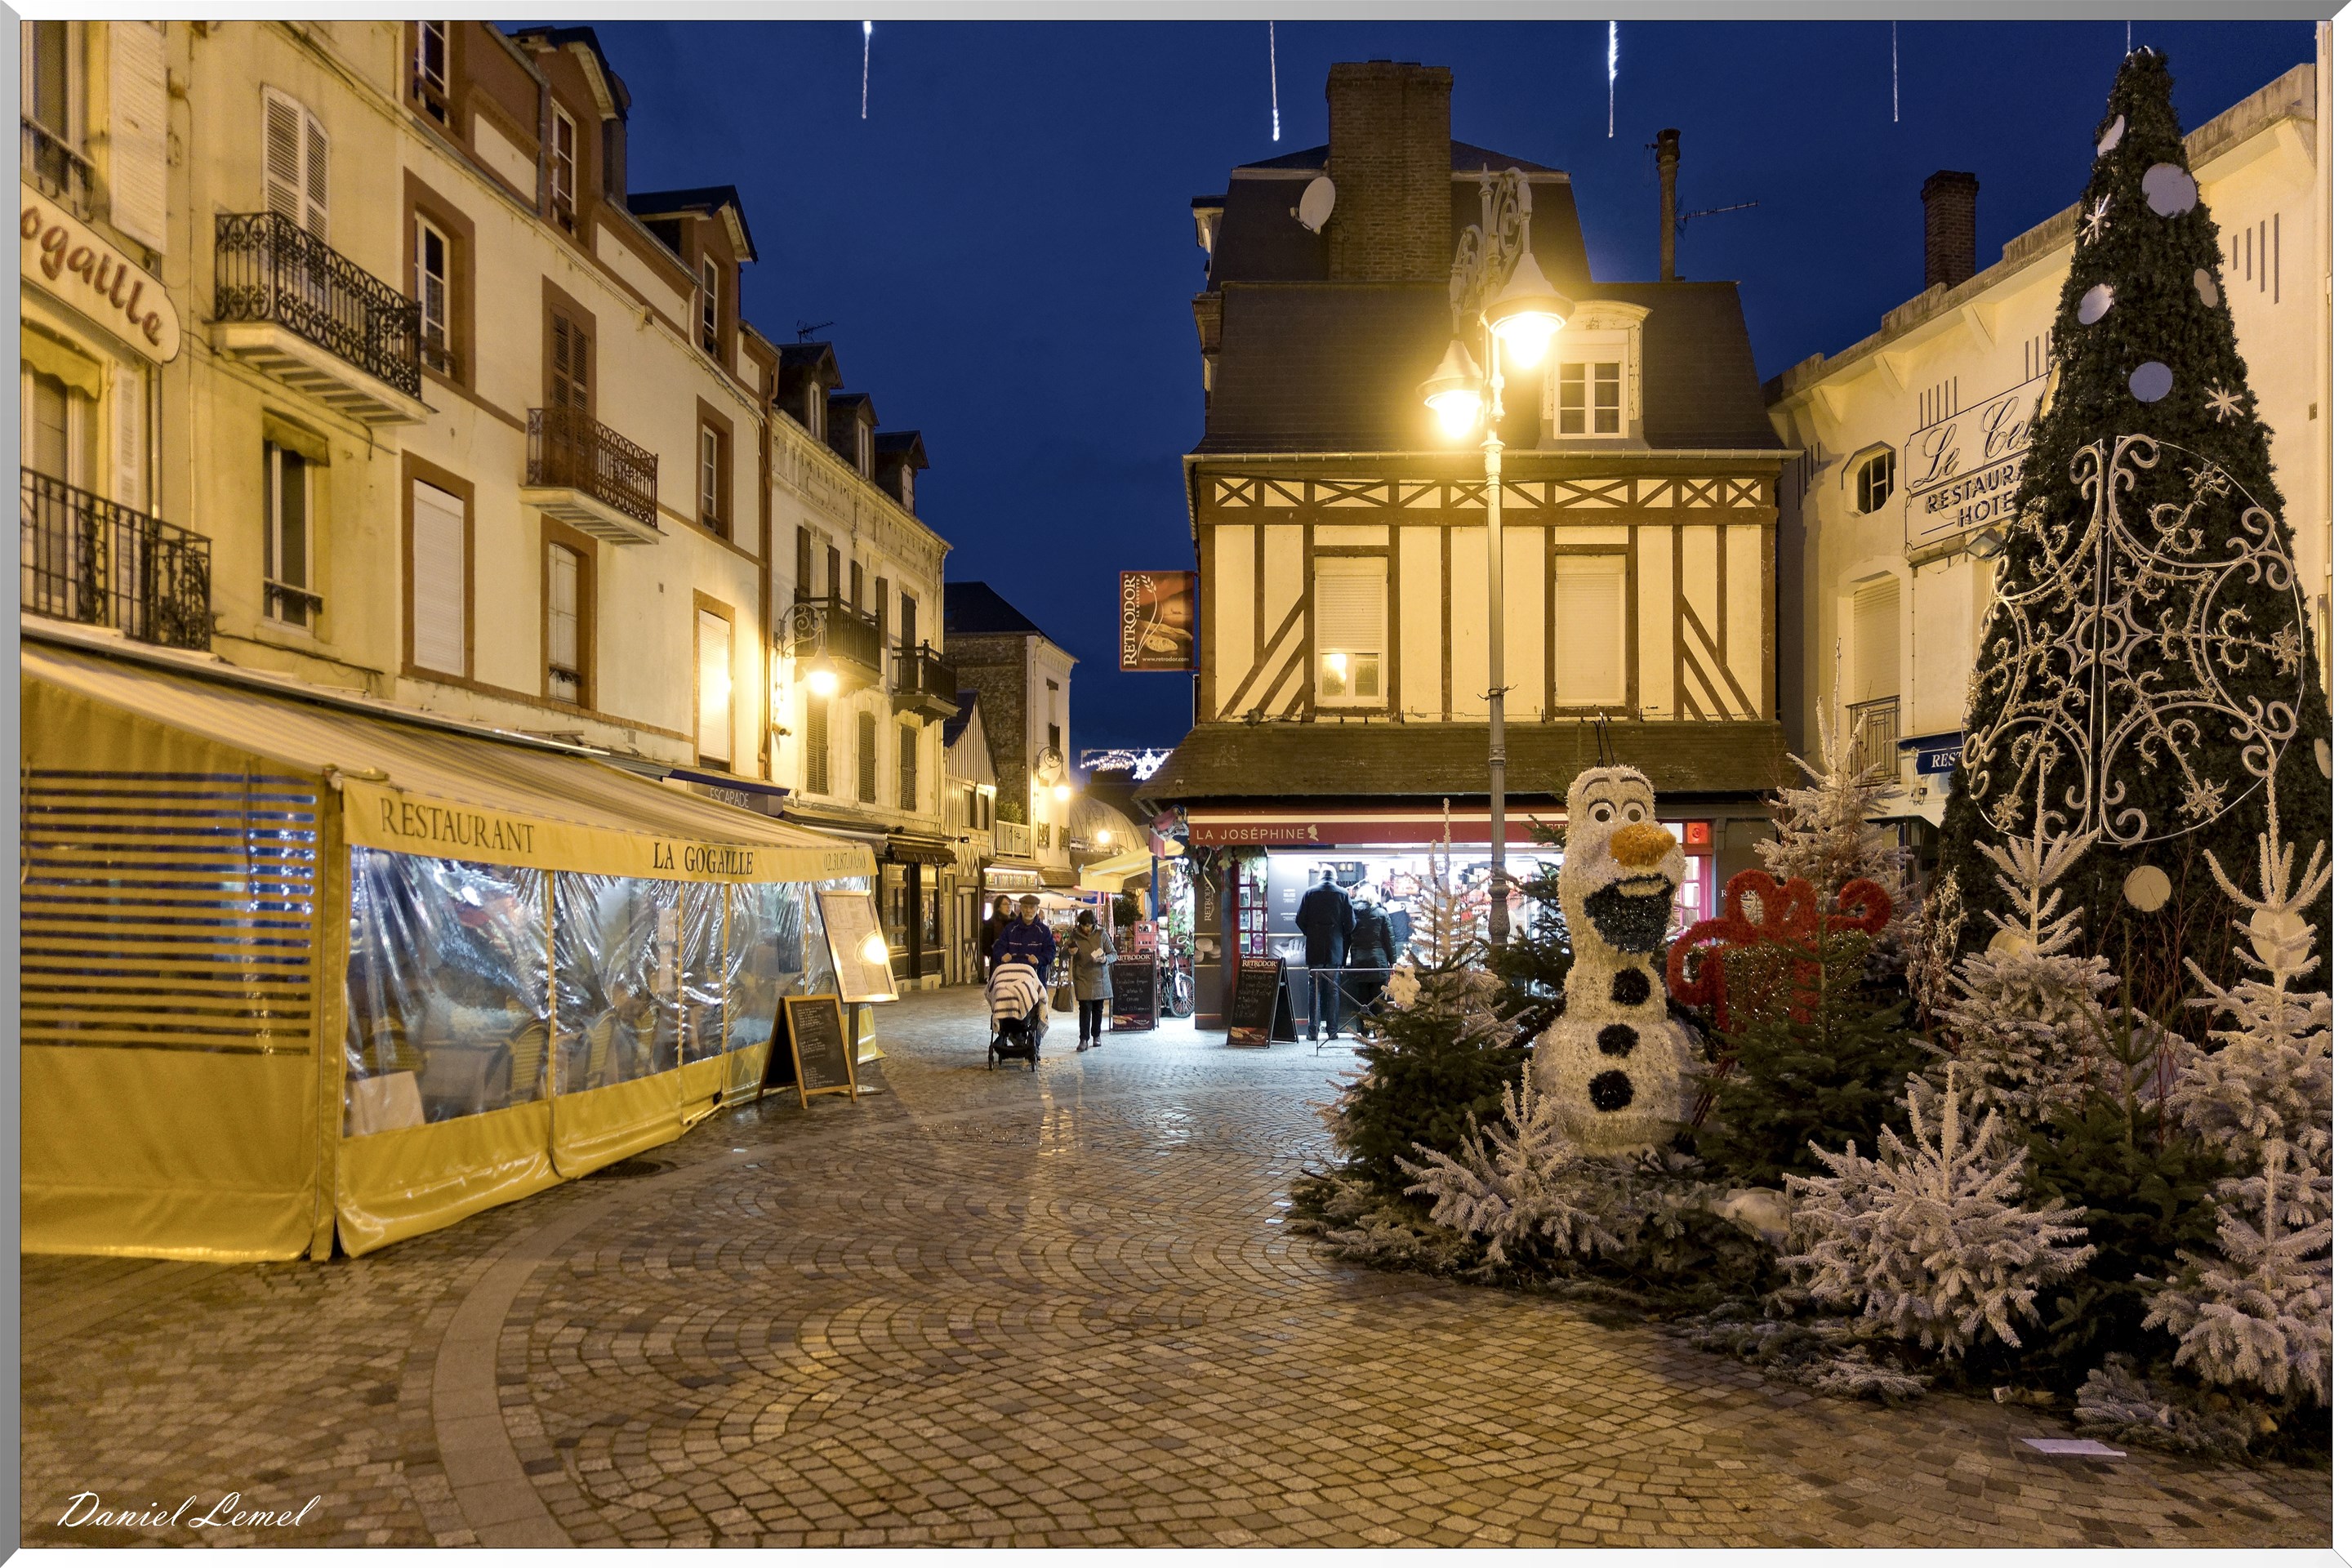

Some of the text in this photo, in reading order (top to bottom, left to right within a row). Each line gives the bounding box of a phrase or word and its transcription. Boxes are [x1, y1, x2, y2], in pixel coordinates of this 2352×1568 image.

[1913, 423, 1960, 488] Le
[1958, 487, 2022, 528] HOTE
[1124, 576, 1137, 666] RETRODOR
[380, 797, 535, 853] RESTAURANT
[1196, 827, 1305, 840] LA JOSÉPHINE
[653, 842, 754, 875] LA GOGAILLE
[1242, 960, 1277, 968] RETRODOR
